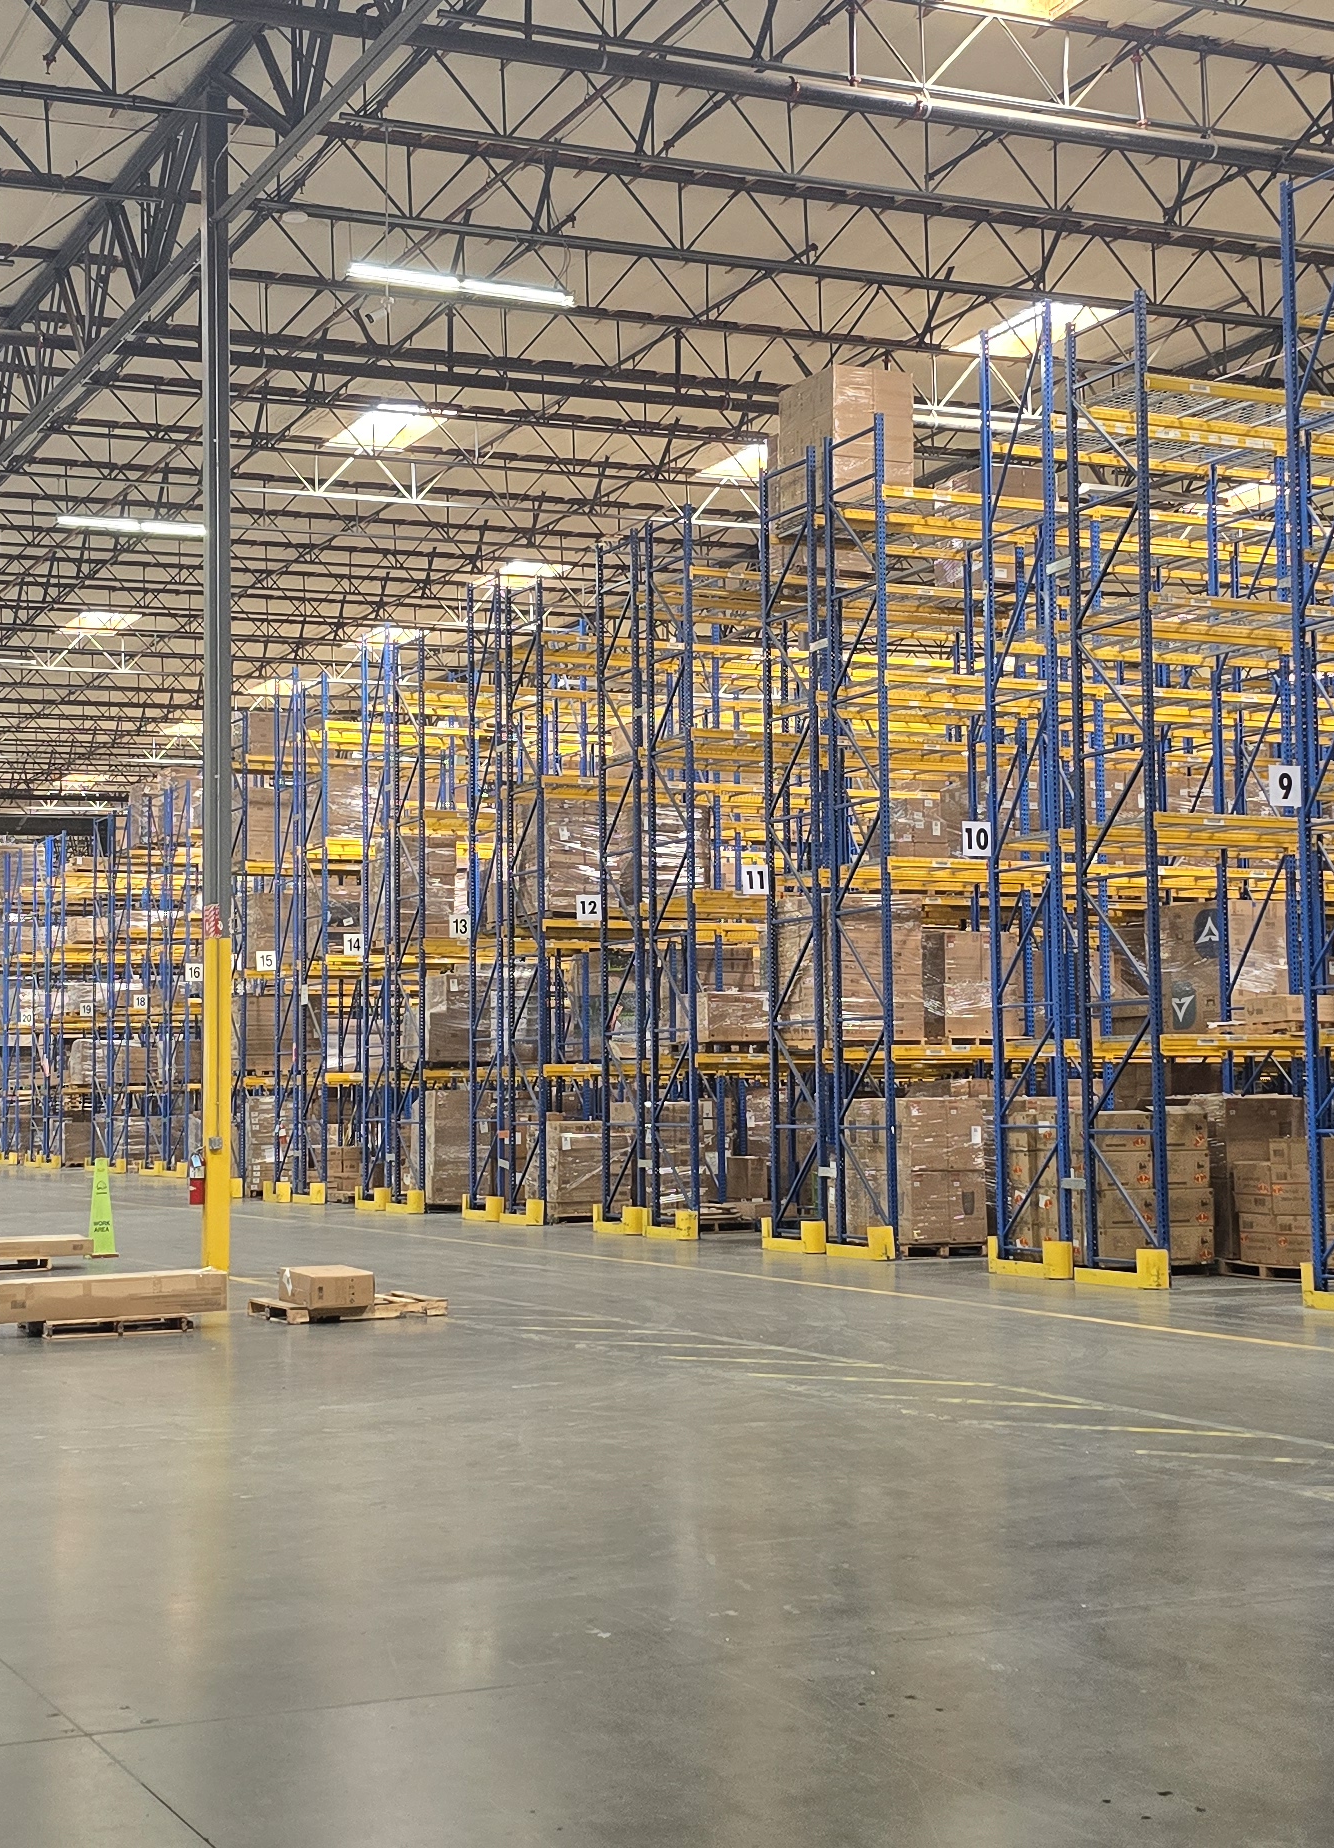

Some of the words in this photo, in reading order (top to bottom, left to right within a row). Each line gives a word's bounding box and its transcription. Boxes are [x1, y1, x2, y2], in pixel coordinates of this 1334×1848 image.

[1278, 772, 1293, 799] 9
[965, 827, 989, 851] 10
[746, 870, 765, 890] 11
[580, 900, 597, 915] 12
[452, 918, 468, 935] 13
[347, 937, 361, 952] 14
[259, 954, 273, 967] 15
[188, 966, 201, 979] 16
[82, 1004, 92, 1014] 19
[136, 996, 146, 1007] 18
[22, 1014, 32, 1023] 20
